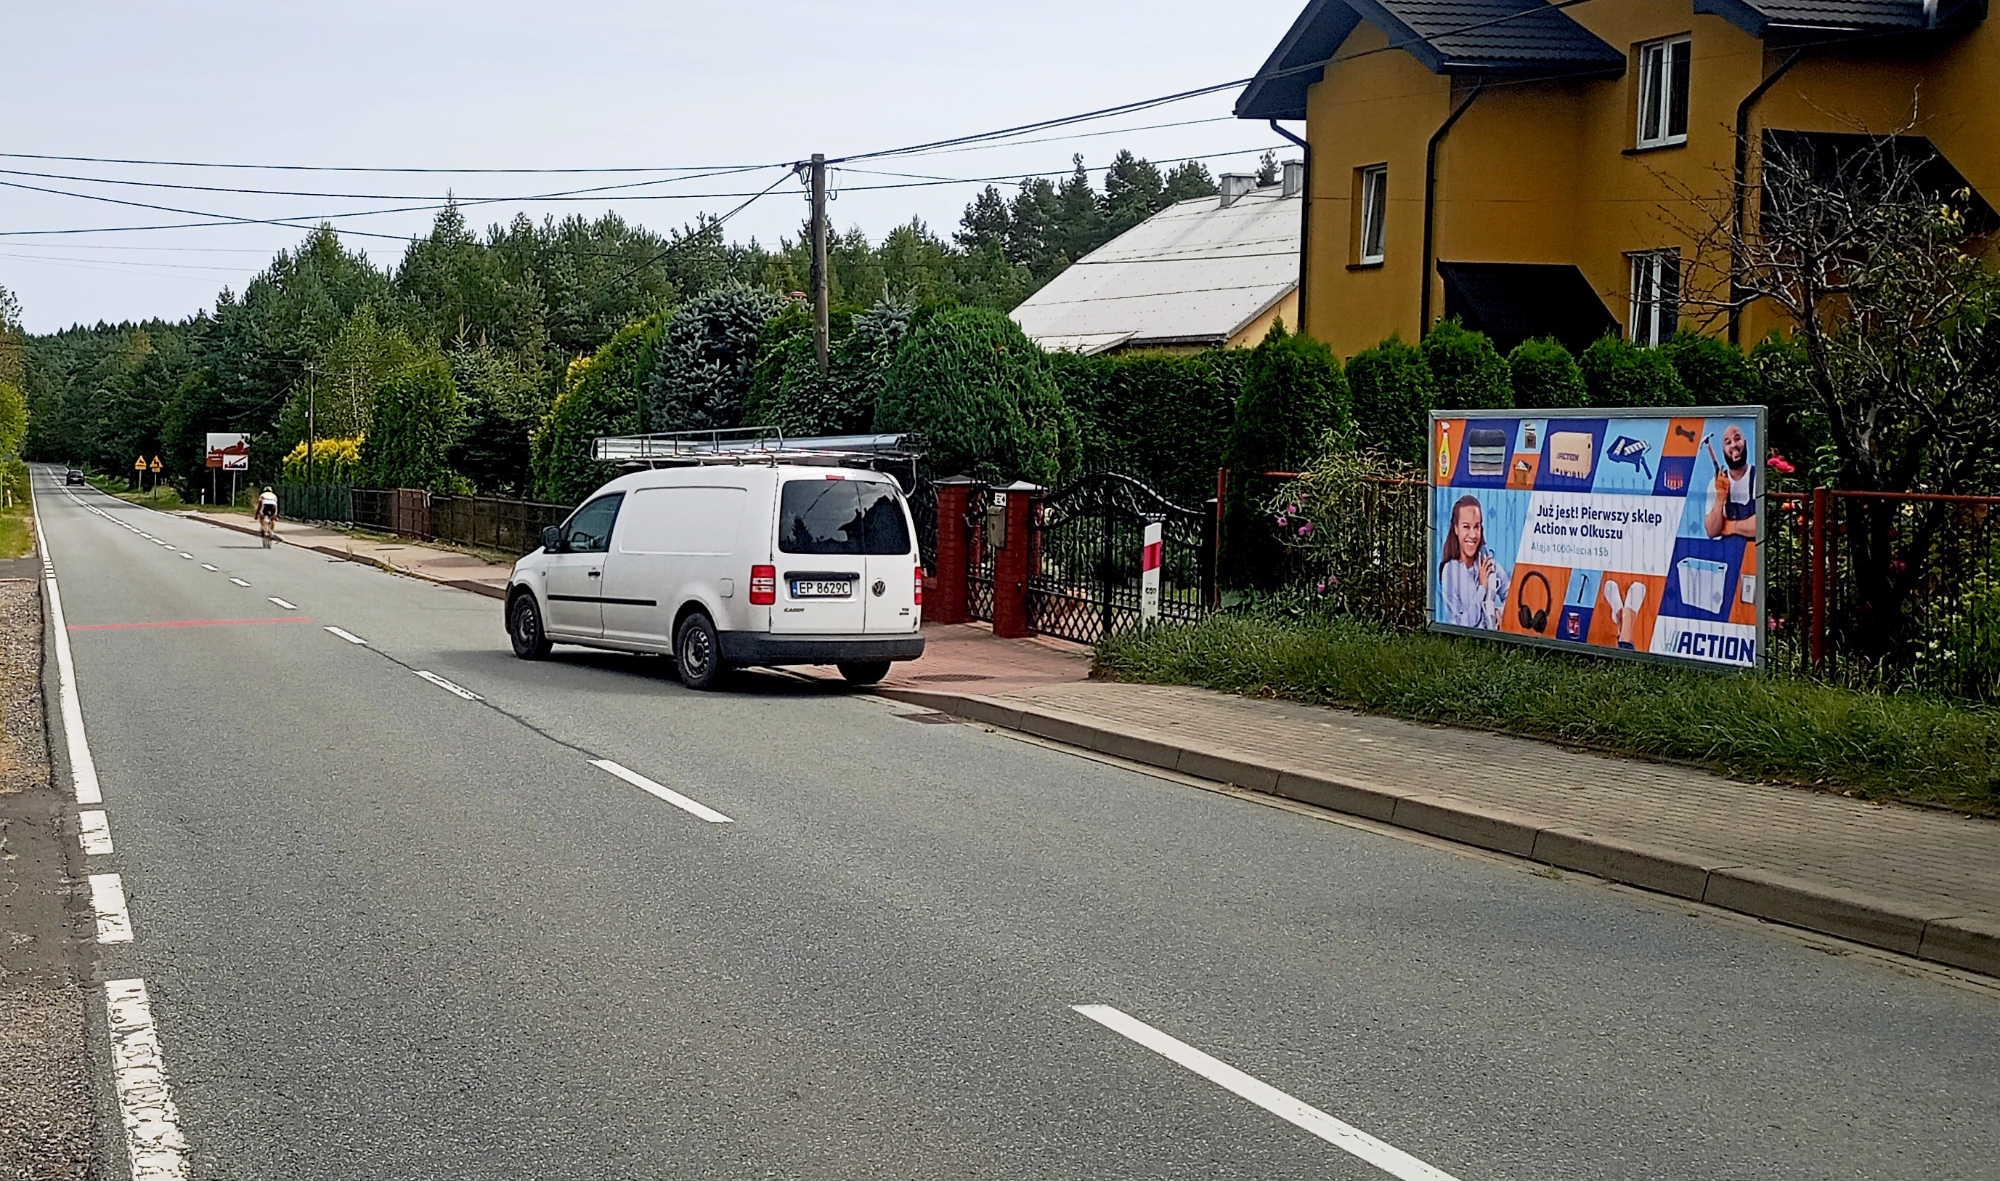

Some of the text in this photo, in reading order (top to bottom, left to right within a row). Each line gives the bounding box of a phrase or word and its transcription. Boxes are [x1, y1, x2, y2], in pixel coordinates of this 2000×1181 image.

[1536, 504, 1662, 526] Już jest! Pierwszy sklep
[1533, 522, 1623, 540] Action w Olkuszu
[799, 582, 849, 594] EP 8629C
[1677, 631, 1755, 662] ACTION
